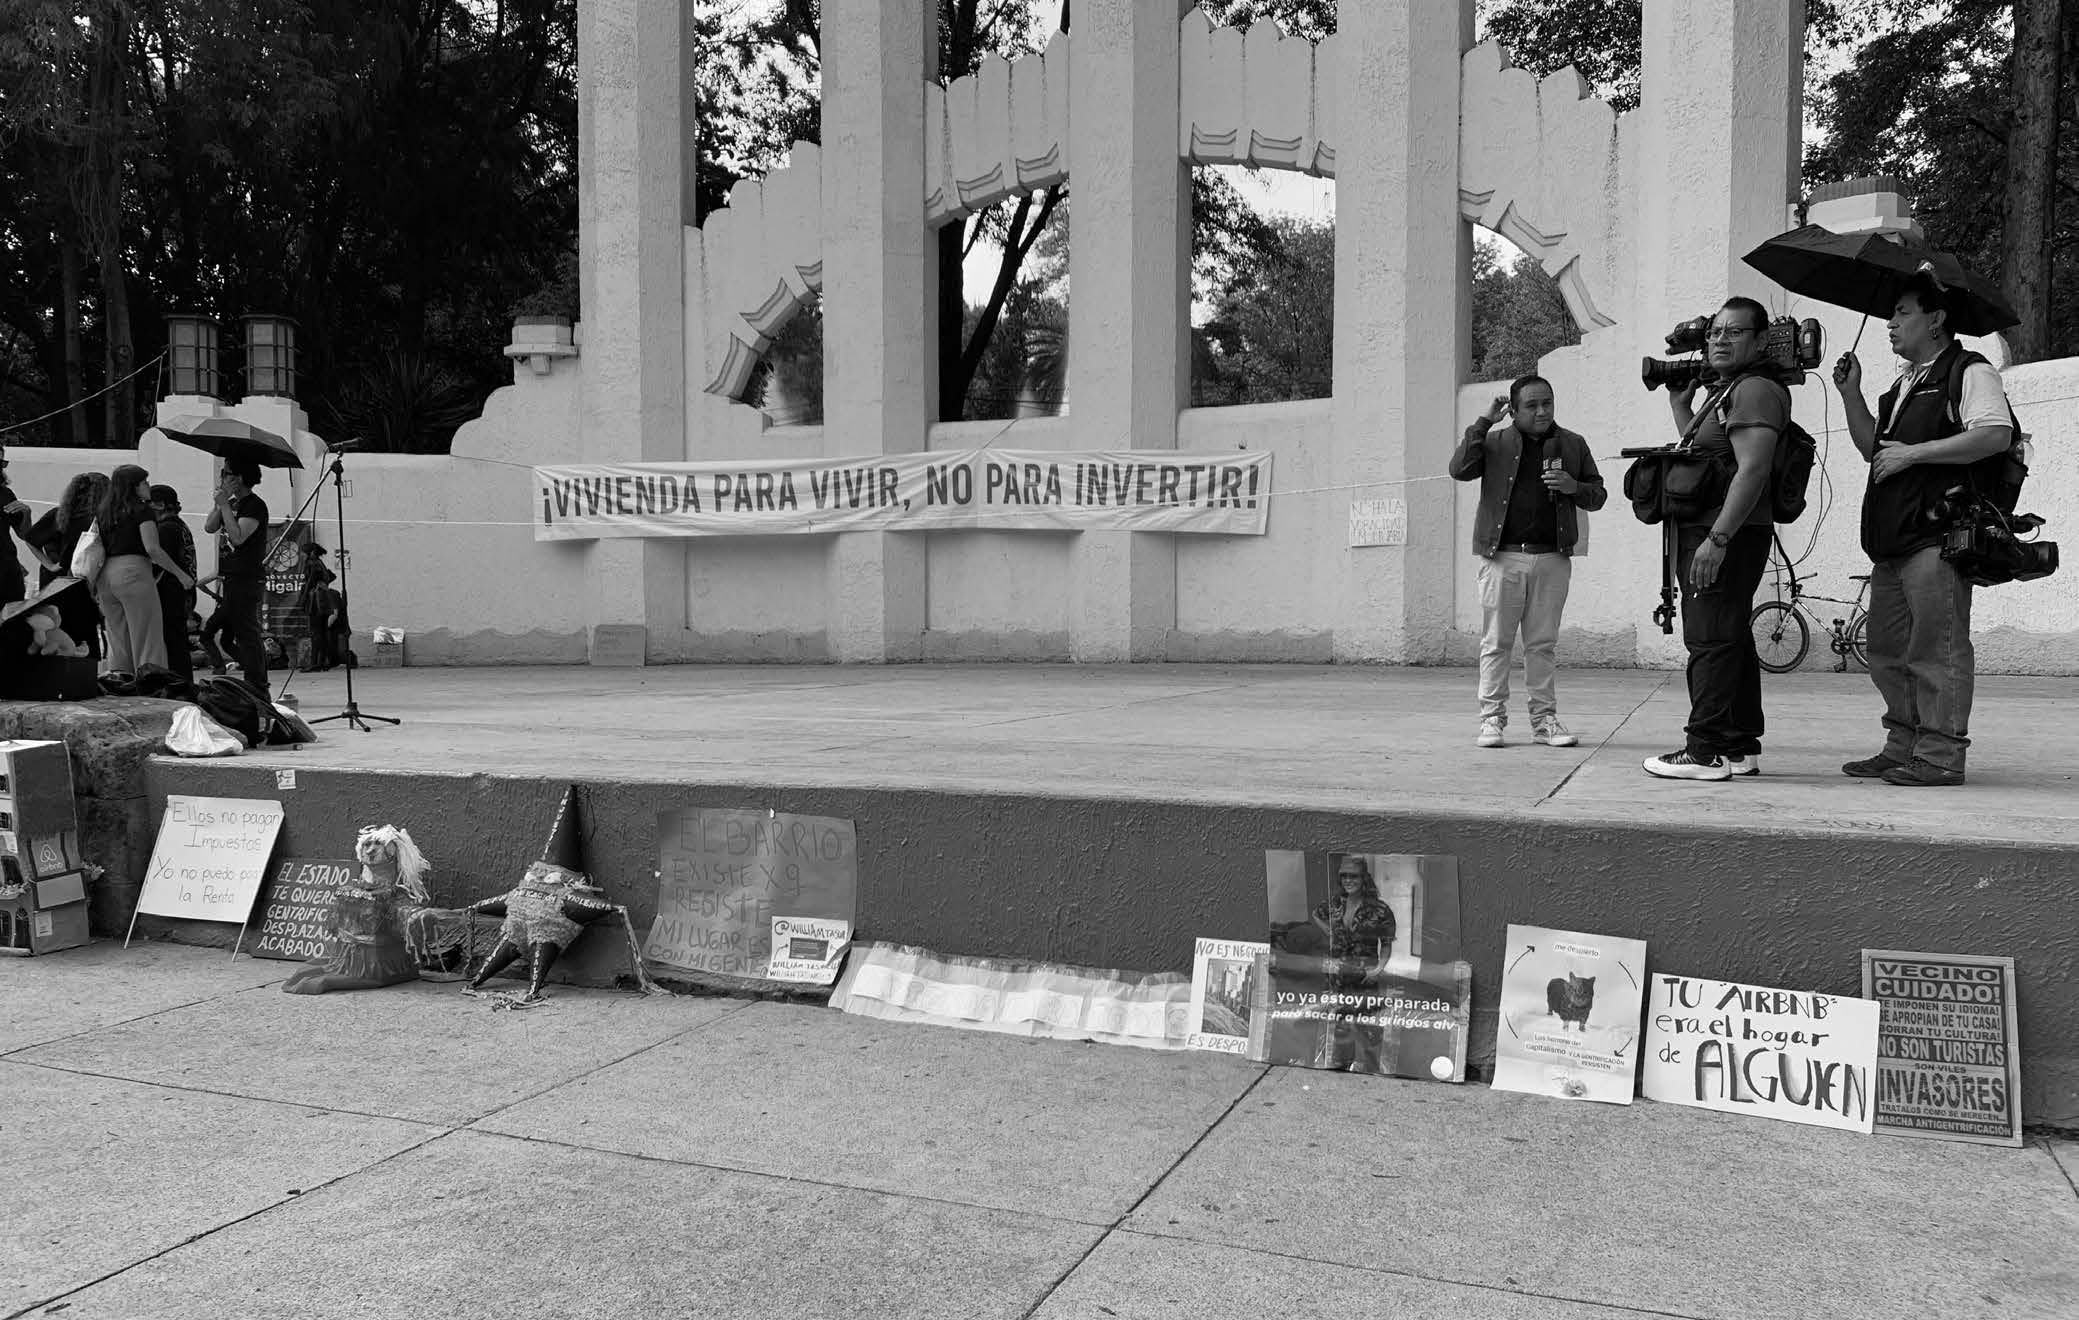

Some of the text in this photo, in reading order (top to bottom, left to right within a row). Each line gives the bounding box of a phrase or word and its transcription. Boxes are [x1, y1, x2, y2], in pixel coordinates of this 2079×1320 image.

[543, 463, 1259, 527] ¡VIVIENDA PARA VIVIR, NO PARA INVERTIR!
[172, 801, 280, 834] Ellos no pagan
[726, 818, 842, 862] BARRIO
[153, 855, 174, 879] Yo
[180, 868, 197, 880] no
[278, 862, 351, 886] EL ESTADO
[179, 884, 192, 903] la
[272, 884, 290, 900] TE
[566, 893, 612, 911] VIOLENCIA
[266, 904, 329, 922] GENTRIFIC
[257, 936, 325, 958] ACABADO
[688, 925, 743, 951] LUGAR
[1195, 941, 1215, 957] NO
[1217, 943, 1231, 958] ES
[1878, 963, 1998, 982] VECINO
[1277, 991, 1450, 1013] yo ya estoy preparada
[1663, 977, 1703, 1009] TU
[1875, 978, 2000, 1004] CUIDADO!
[1893, 1000, 1939, 1011] IMPONEN
[1942, 1003, 1956, 1013] SU
[1959, 1004, 1999, 1016] IDIOMA!
[1304, 1010, 1343, 1021] sacar
[1345, 1012, 1354, 1023] a
[1356, 1013, 1376, 1025] los
[1378, 1013, 1430, 1031] gringos
[1892, 1010, 1939, 1027] APROPIAN
[1941, 1014, 1954, 1028] DE
[1956, 1015, 1970, 1029] TU
[1972, 1016, 2001, 1031] CASA!
[1187, 1033, 1247, 1053] ES DESPO
[1656, 1014, 1829, 1050] era el hogar
[1879, 1024, 2001, 1042] BORRAN TU CULTURA!
[1658, 1041, 1681, 1064] de
[1879, 1036, 2005, 1066] NO SON TURISTAS
[1915, 1062, 1967, 1074] SON VILES
[1879, 1068, 2005, 1113] INVASORES
[1876, 1114, 1913, 1127] MARCHA
